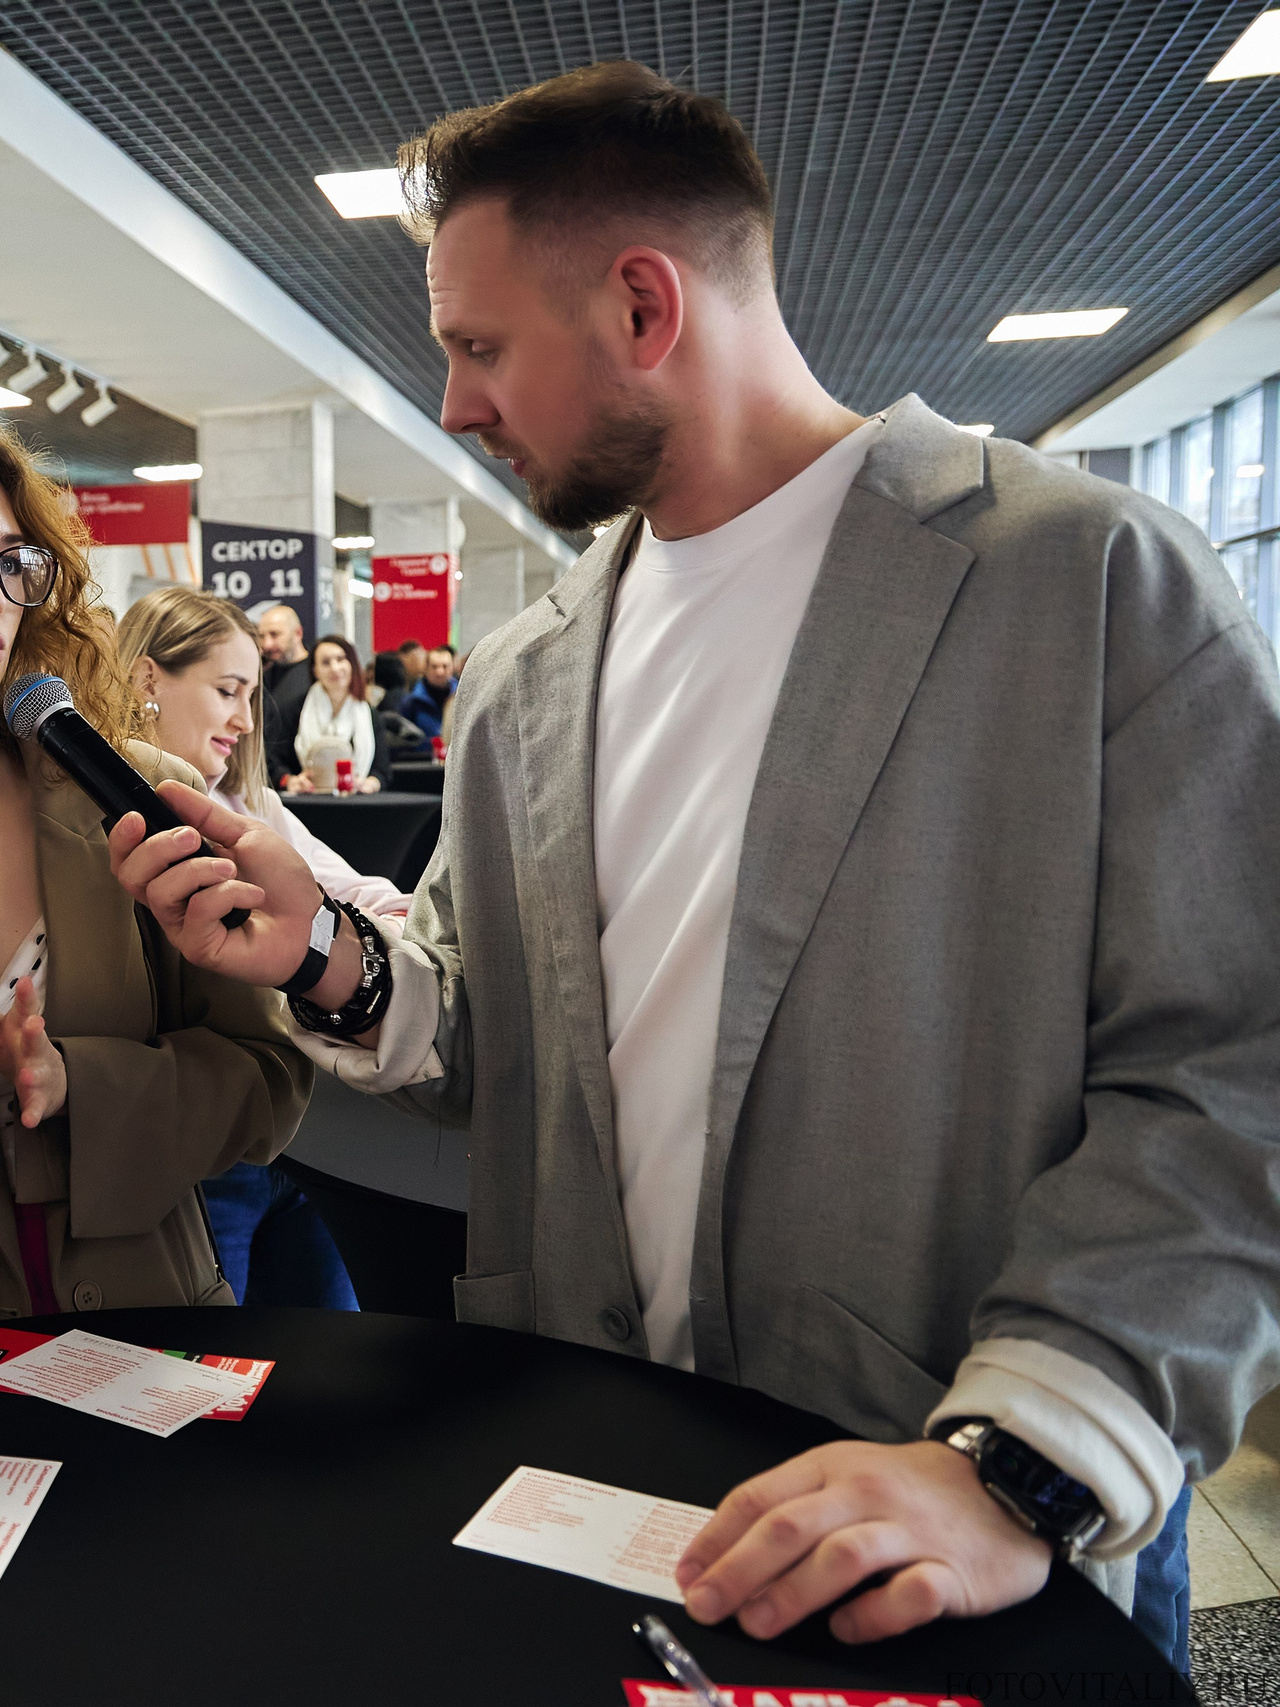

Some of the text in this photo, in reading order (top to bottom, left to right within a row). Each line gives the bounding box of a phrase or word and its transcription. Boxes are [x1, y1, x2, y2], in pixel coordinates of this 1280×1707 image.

[211, 537, 304, 563] СЕКТОР
[211, 570, 251, 599] 10
[270, 568, 304, 597] 11
